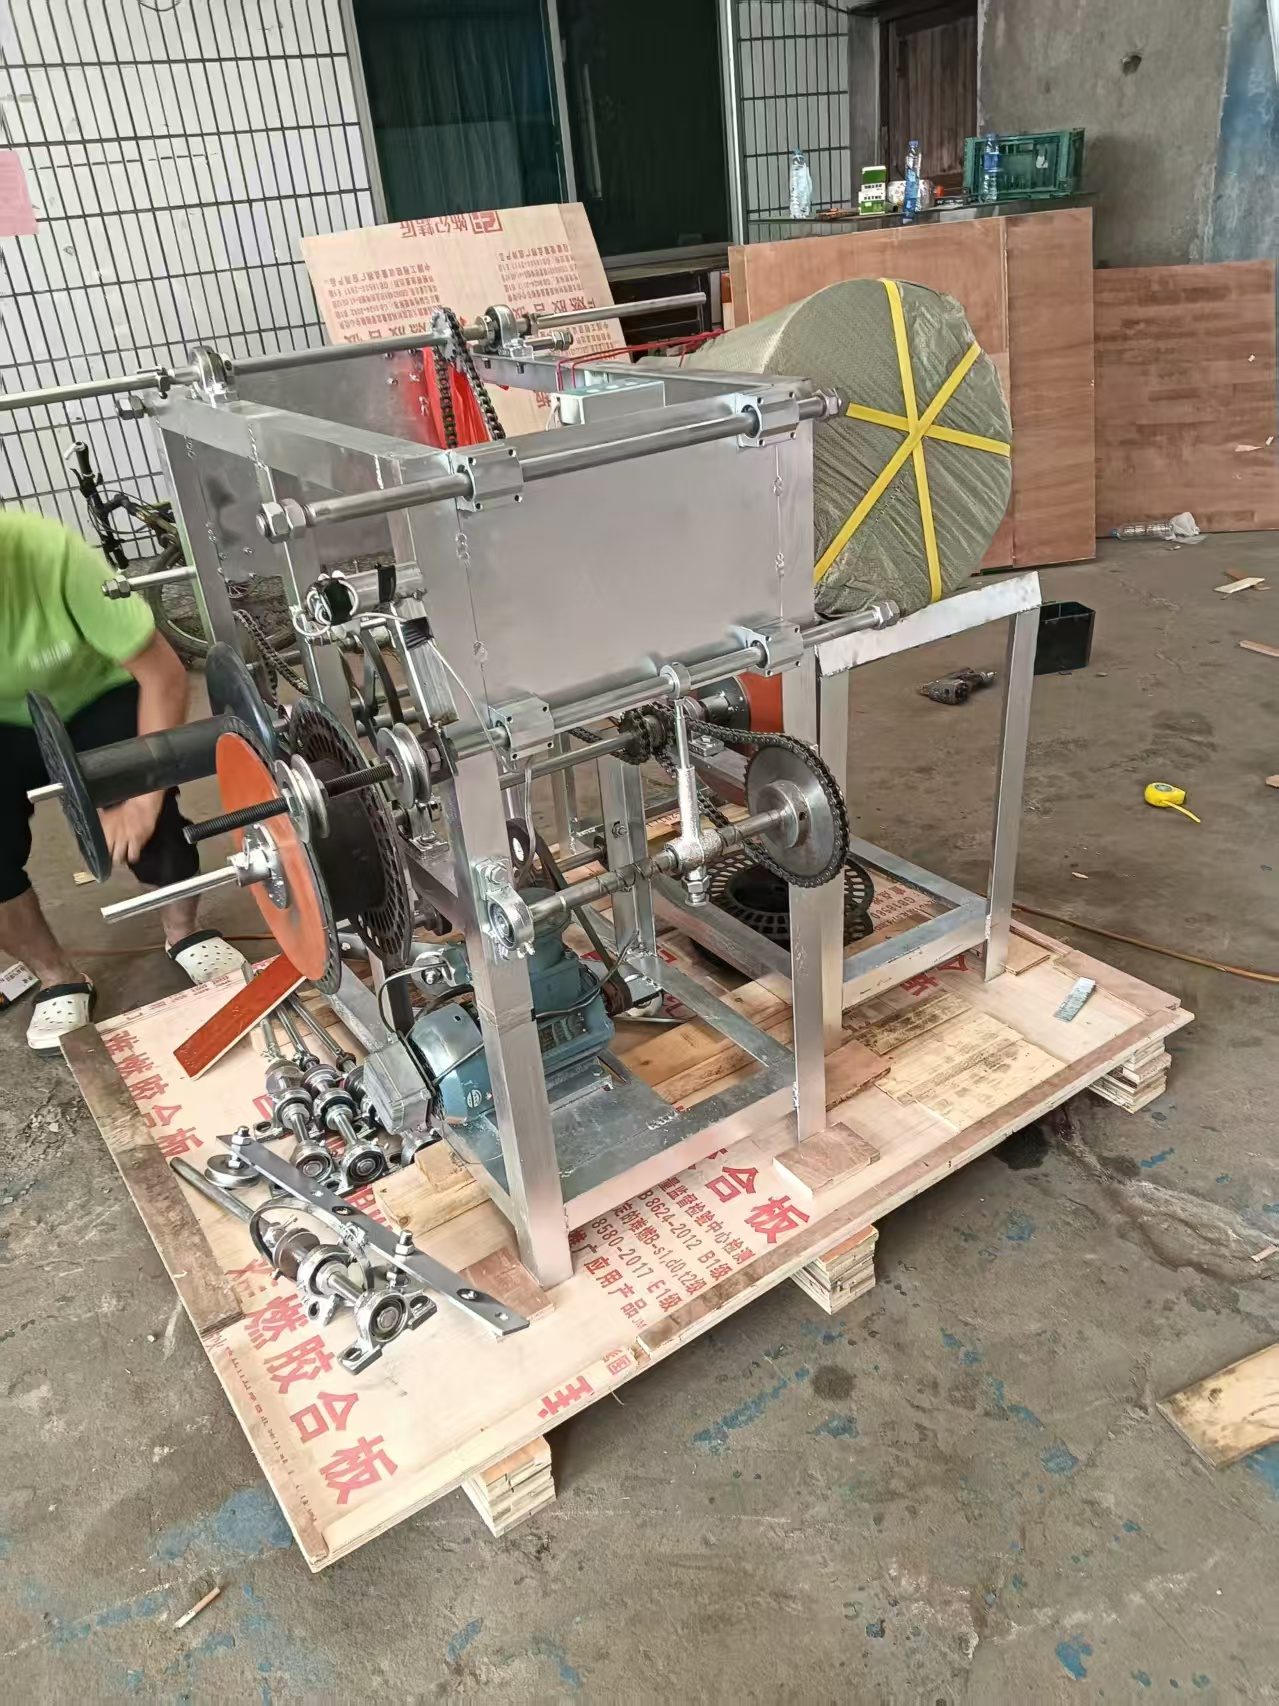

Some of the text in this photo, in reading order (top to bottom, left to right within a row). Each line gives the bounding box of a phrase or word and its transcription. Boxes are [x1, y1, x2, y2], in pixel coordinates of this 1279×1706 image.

[687, 1148, 811, 1244] 合板
[225, 1258, 399, 1505] 燃胶合板
